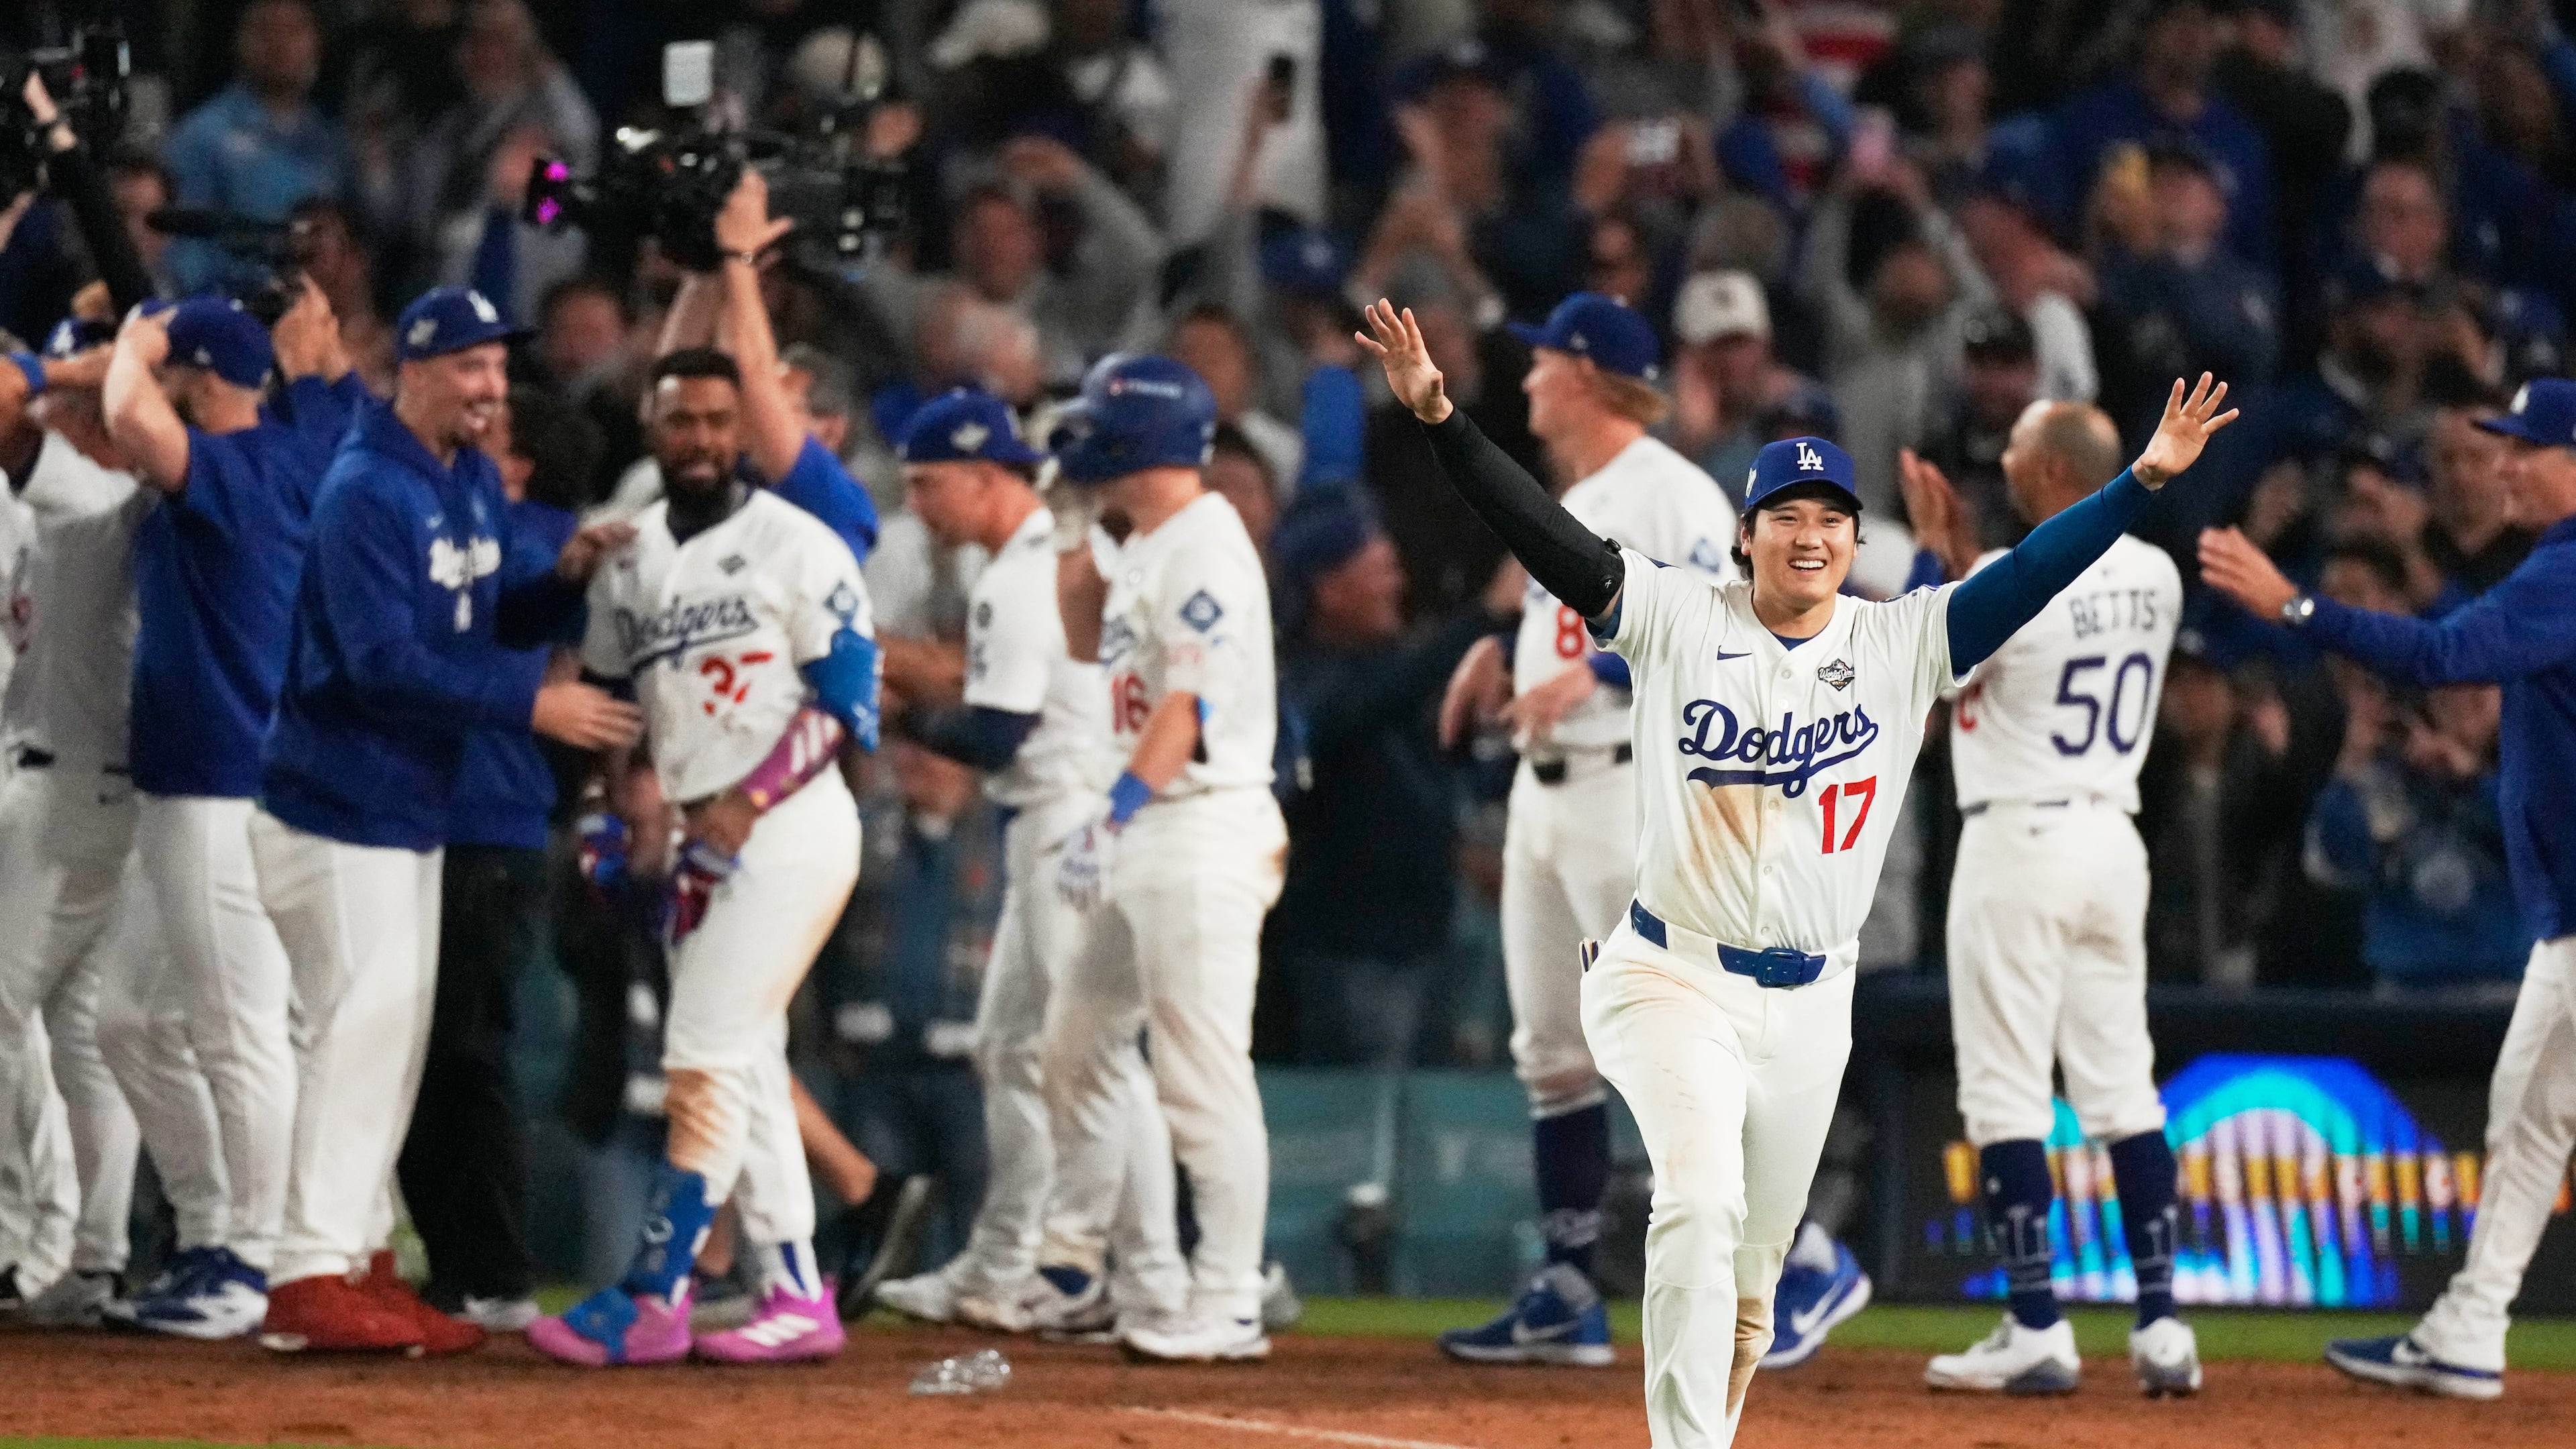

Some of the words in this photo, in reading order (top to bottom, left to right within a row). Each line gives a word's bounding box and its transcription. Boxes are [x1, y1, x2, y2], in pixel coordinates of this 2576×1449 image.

[1796, 442, 1825, 472] LA
[613, 593, 760, 672] Dodgers
[2069, 588, 2157, 639] BETTS
[1110, 672, 1152, 735] 16
[2050, 651, 2153, 757] 50
[1678, 698, 1879, 798] Dodgers
[1818, 774, 1877, 855] 17
